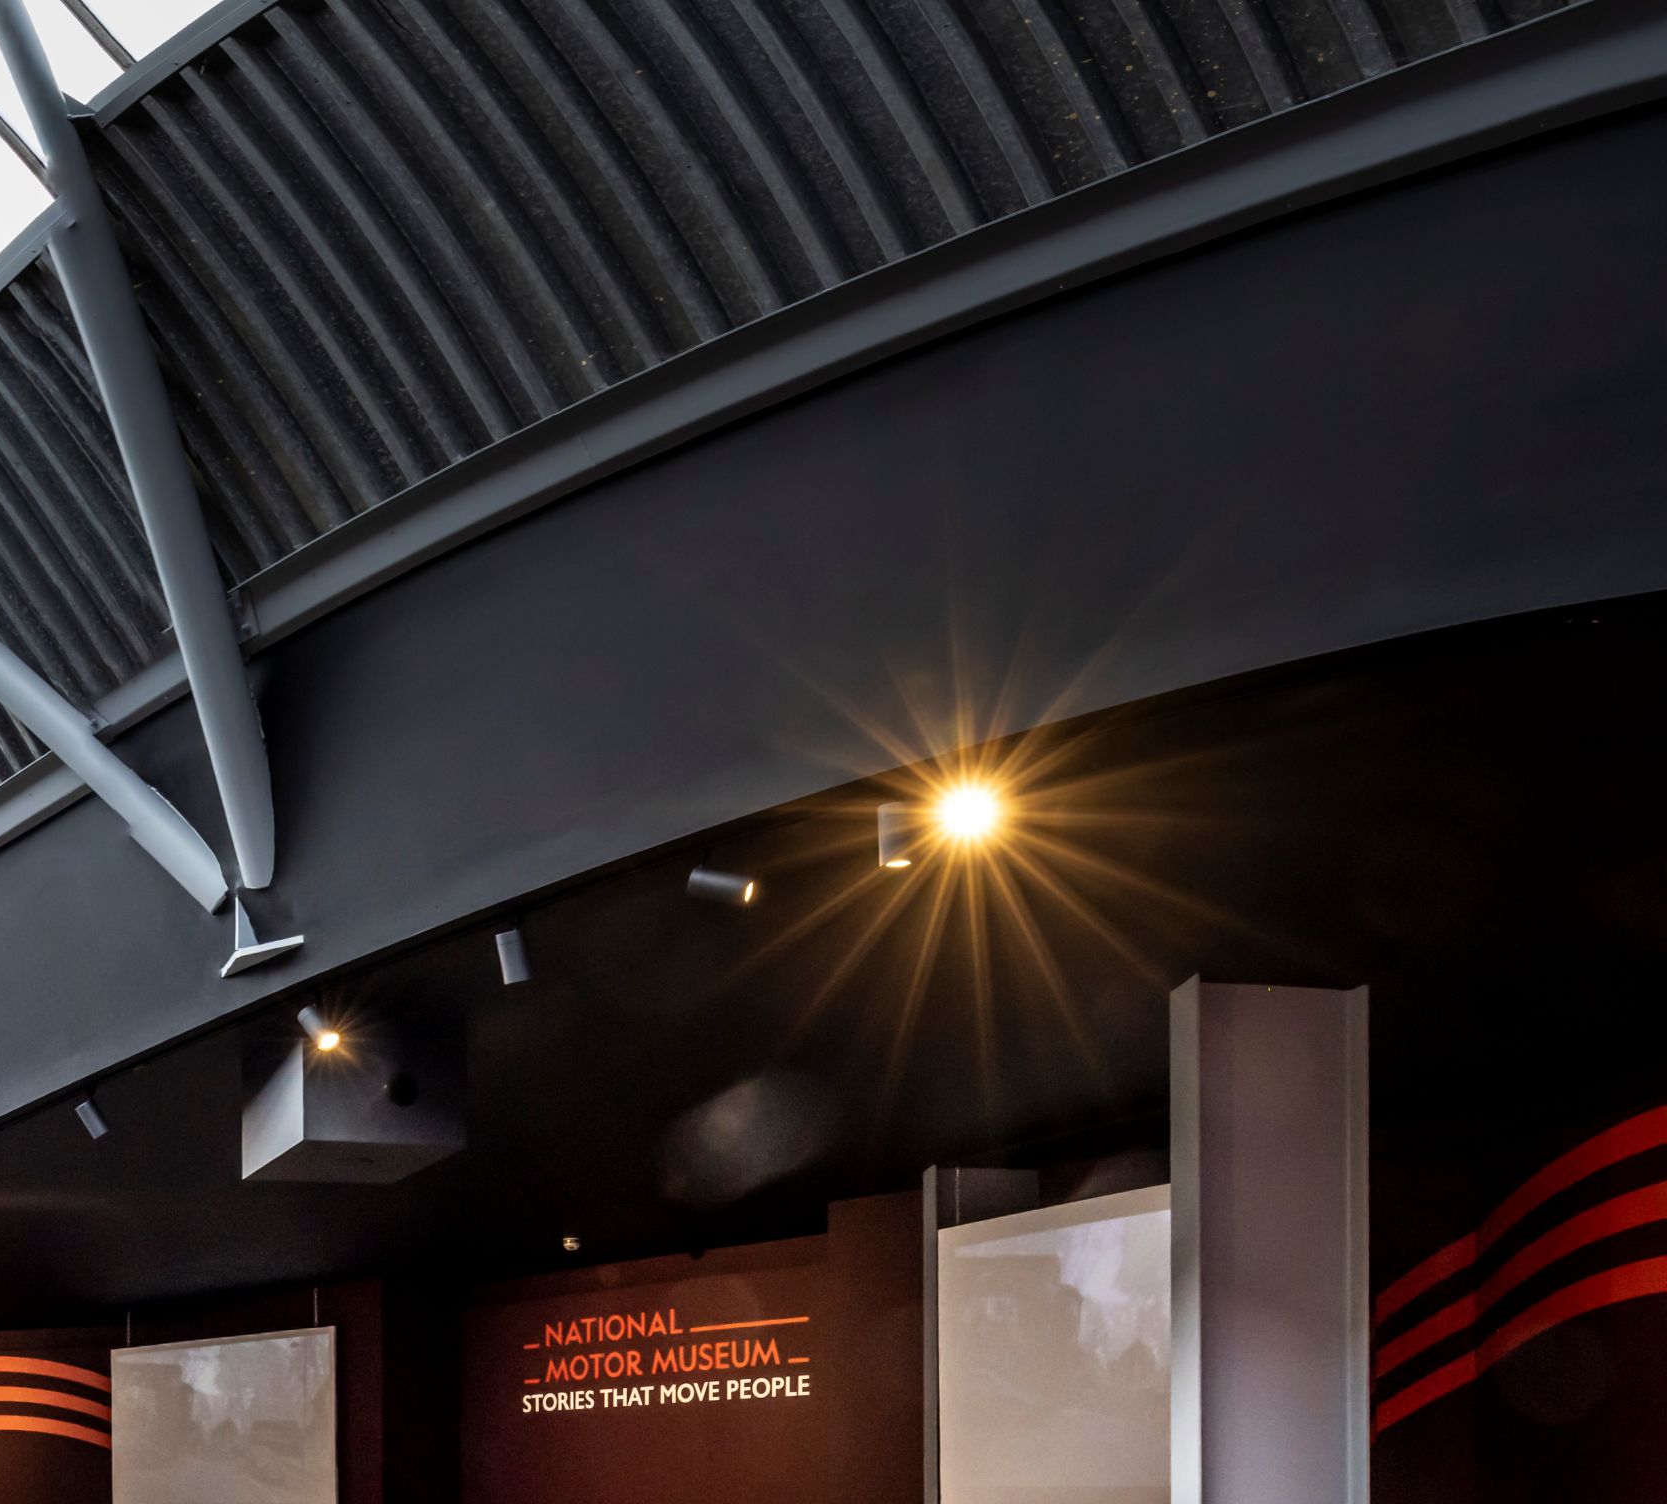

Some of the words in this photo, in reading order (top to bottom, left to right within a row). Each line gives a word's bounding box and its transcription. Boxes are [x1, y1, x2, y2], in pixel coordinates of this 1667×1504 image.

[545, 1308, 683, 1347] NATIONAL
[545, 1351, 643, 1383] MOTOR
[651, 1338, 781, 1374] MUSEUM
[522, 1389, 595, 1413] STORIES
[599, 1385, 655, 1409] THAT
[660, 1380, 720, 1404] MOVE
[726, 1374, 811, 1400] PEOPLE
